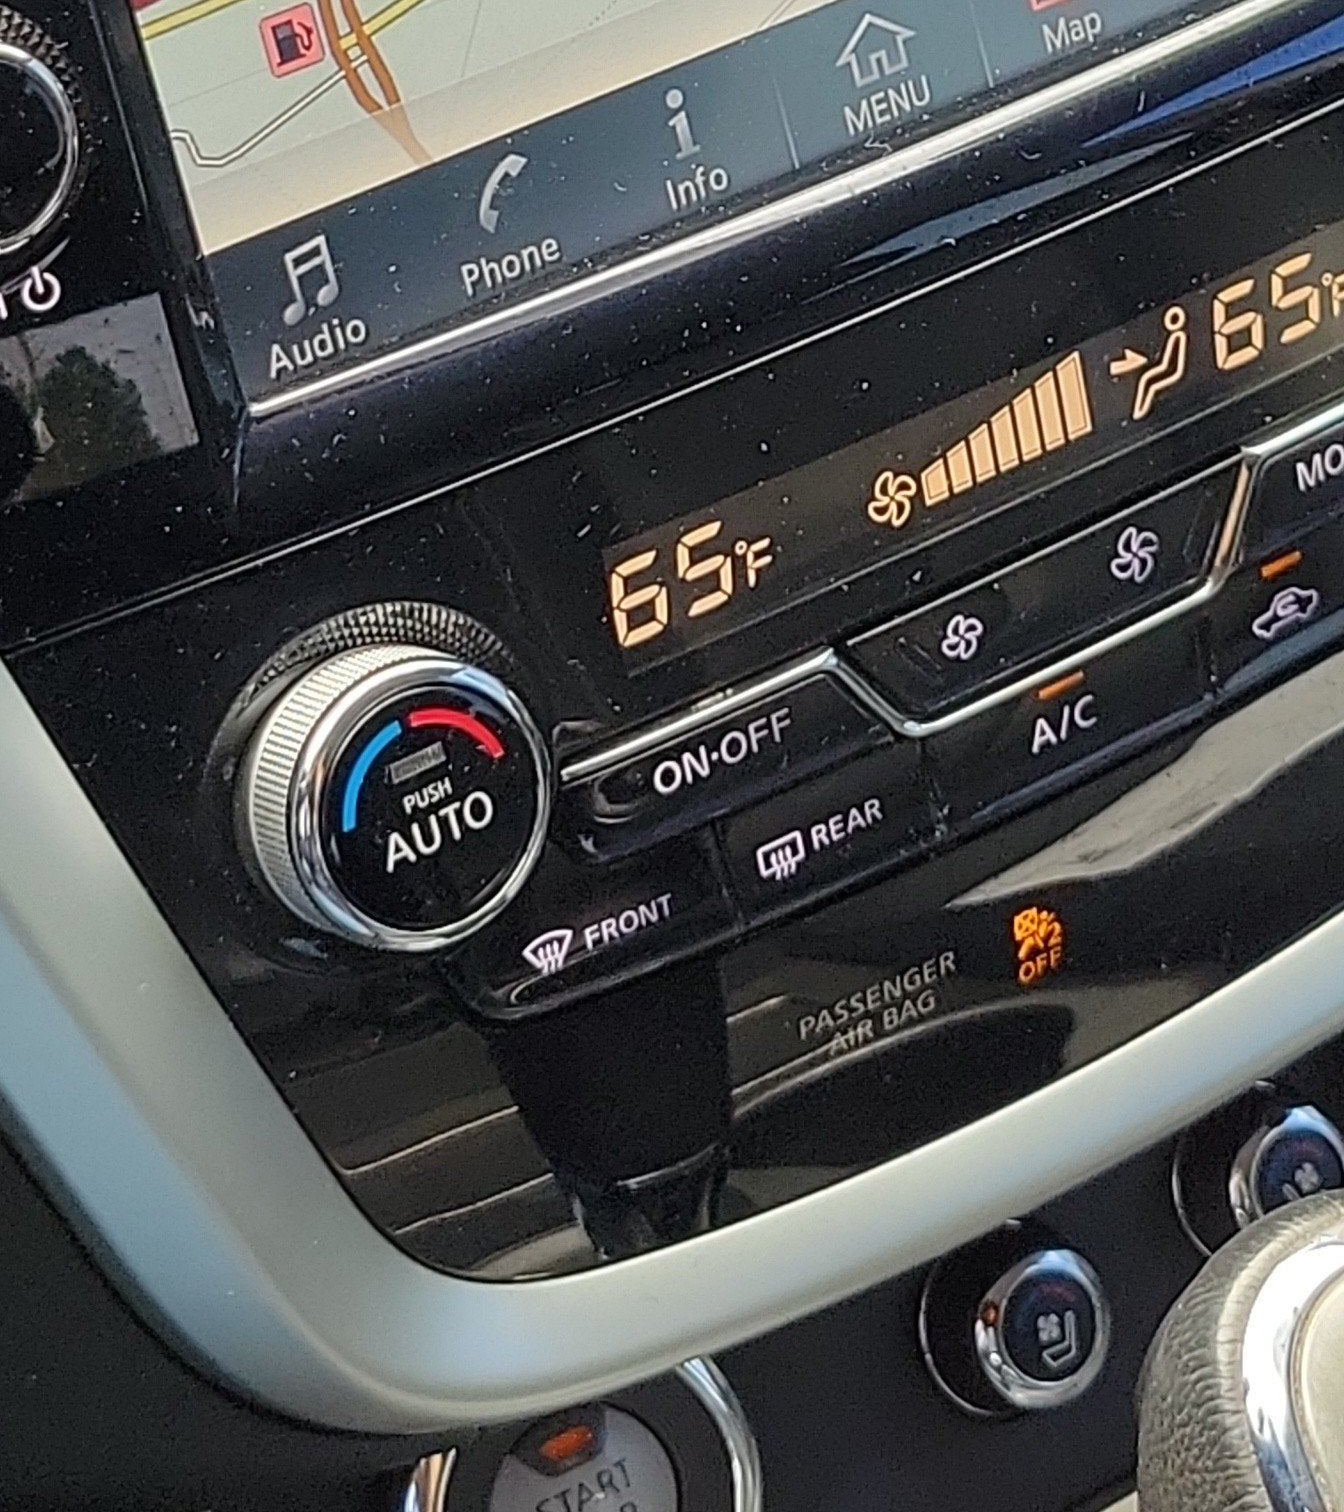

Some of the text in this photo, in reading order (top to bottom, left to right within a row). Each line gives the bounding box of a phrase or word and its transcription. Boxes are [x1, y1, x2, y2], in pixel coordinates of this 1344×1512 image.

[1041, 11, 1103, 56] Map
[843, 74, 933, 138] MENU
[665, 163, 730, 213] Info
[461, 235, 562, 297] Phone
[269, 317, 368, 380] Audio
[1030, 693, 1099, 755] A/C
[401, 776, 453, 816] PUSH
[809, 798, 885, 851] REAR
[384, 790, 495, 875] AUTO
[584, 893, 674, 952] FRONT
[798, 950, 957, 1041] PASSENGER
[1018, 945, 1062, 984] OFF
[826, 988, 937, 1059] AIR BAG
